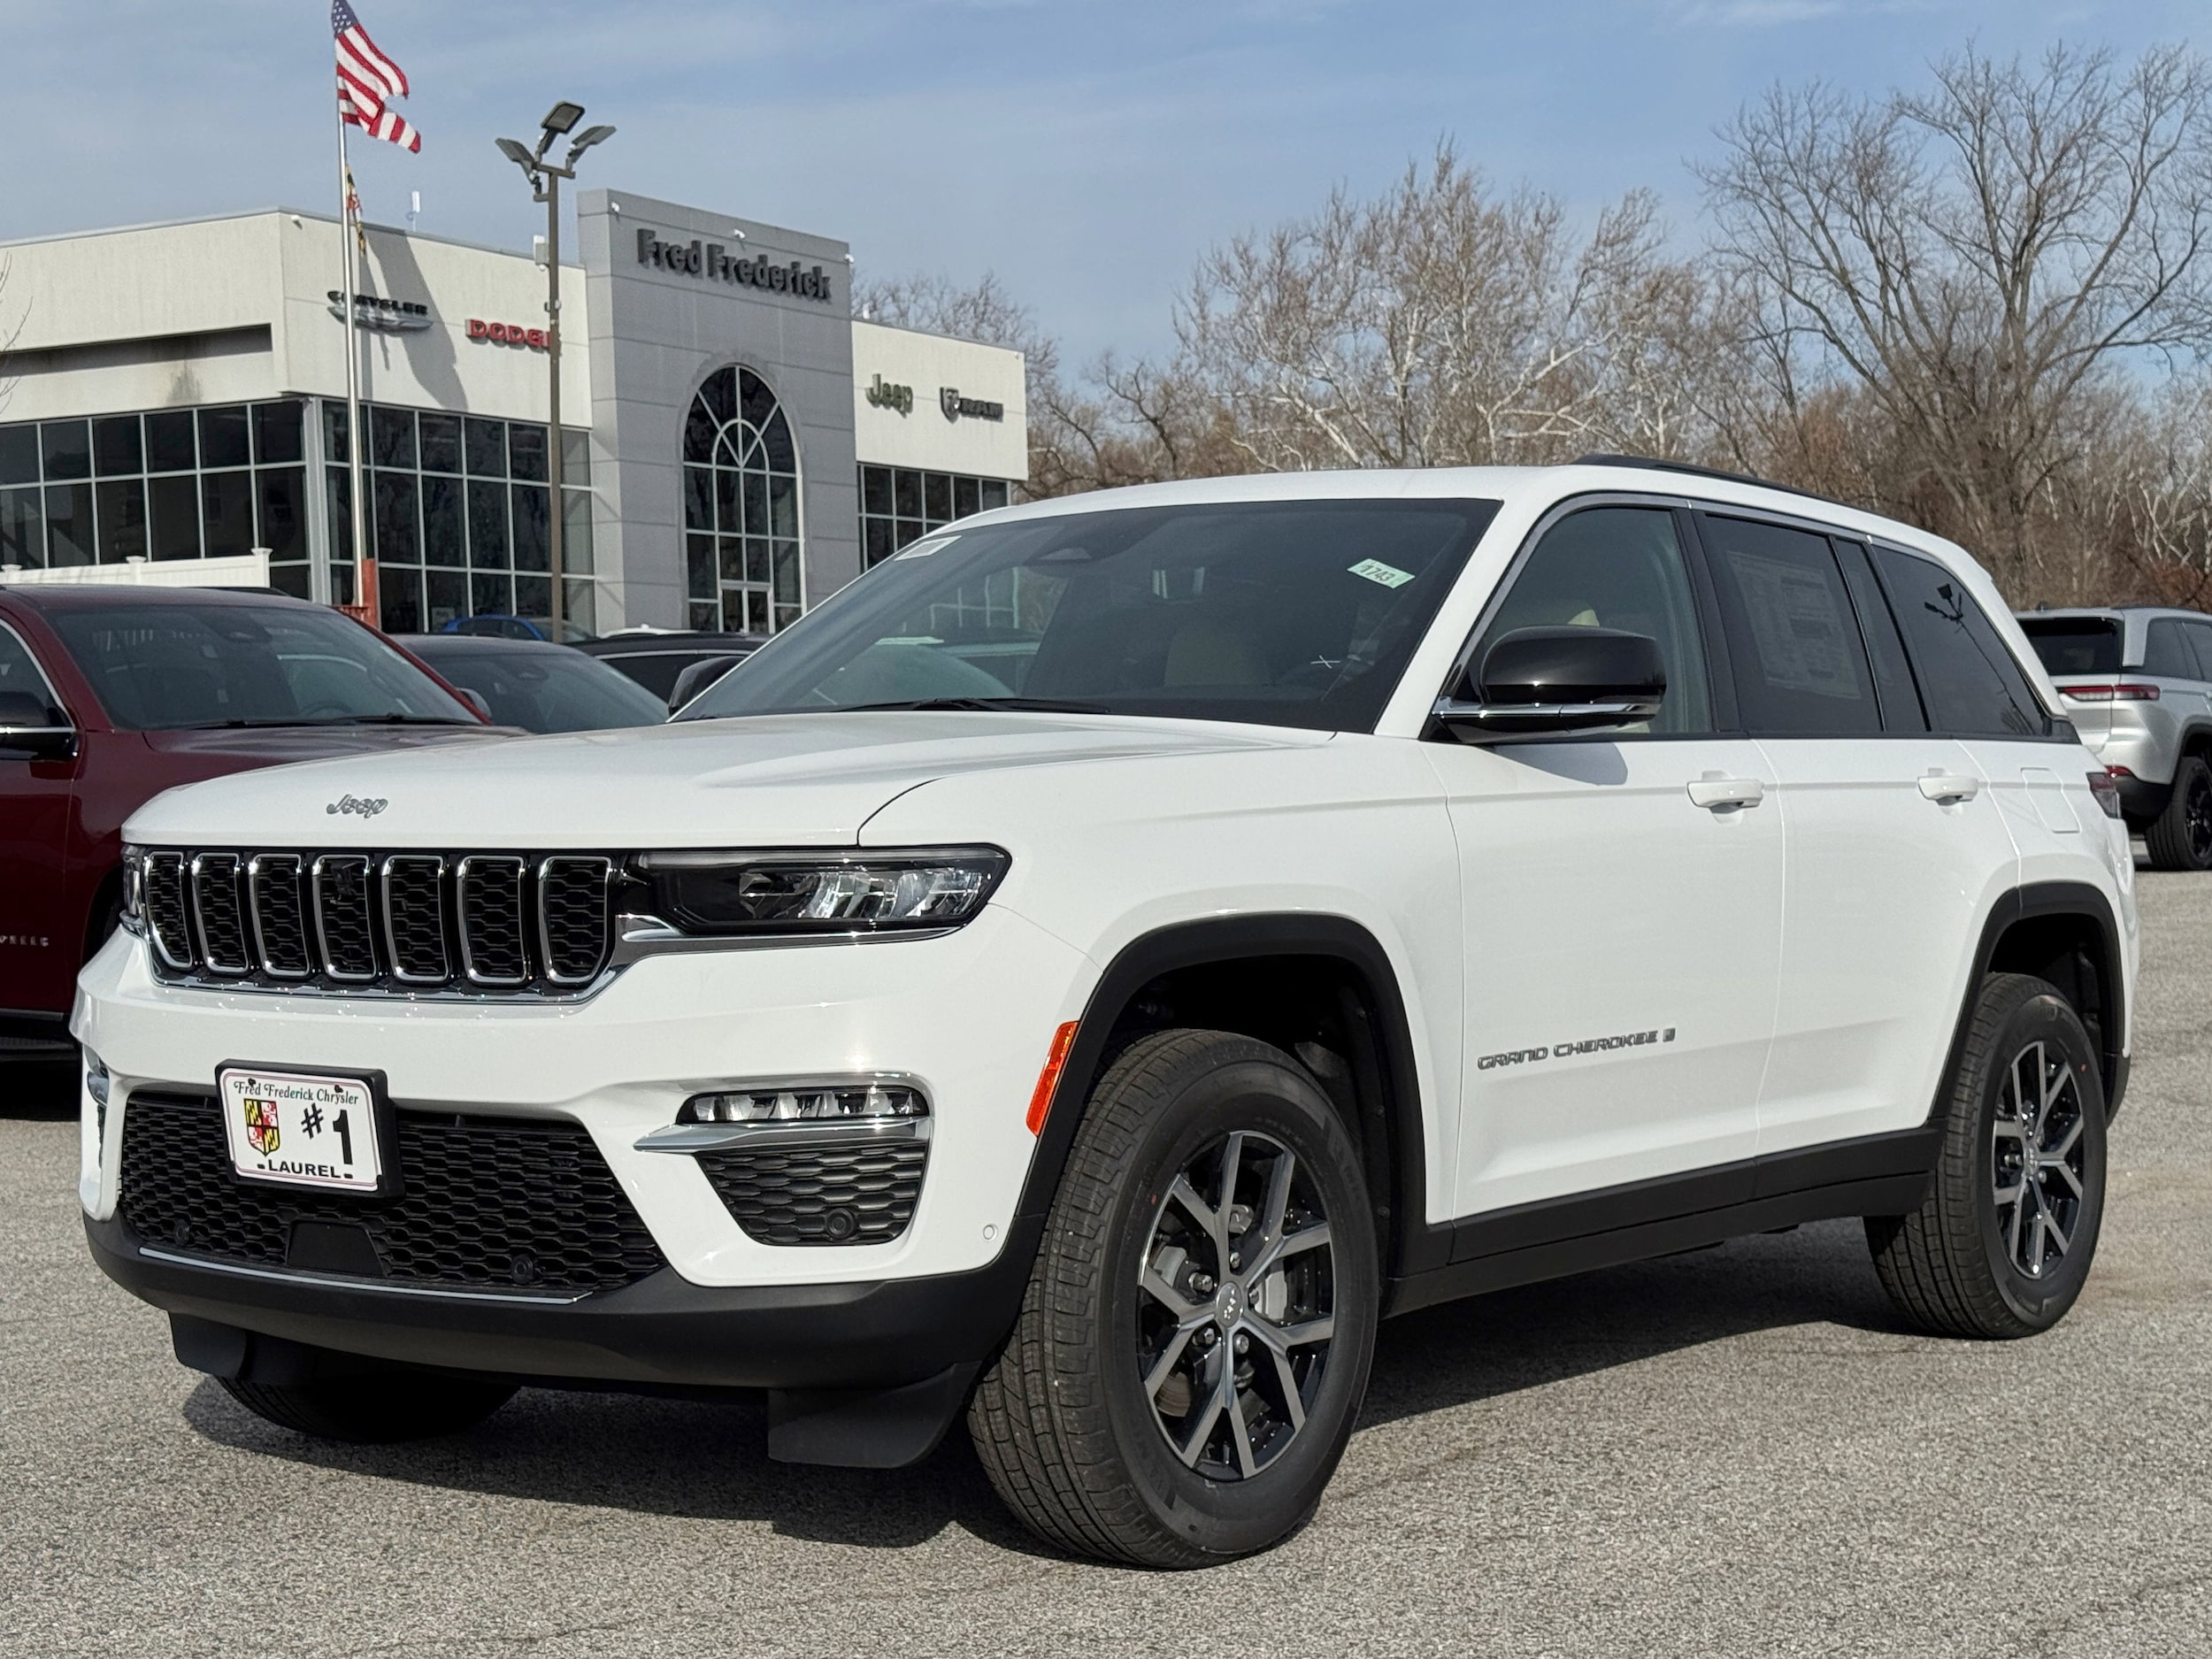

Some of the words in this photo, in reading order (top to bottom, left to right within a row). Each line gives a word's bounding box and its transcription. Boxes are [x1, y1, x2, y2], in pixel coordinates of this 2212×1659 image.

[637, 228, 701, 275] Fred
[707, 243, 831, 301] Frederick
[864, 373, 913, 418] Jeep
[959, 397, 1004, 422] RAM
[1360, 565, 1396, 581] 1743
[326, 794, 389, 818] Jeep
[1478, 1046, 1548, 1070] GRAND
[1554, 1029, 1659, 1058] CHEROKEE
[234, 1080, 261, 1096] Fred
[264, 1083, 313, 1101] Frederick
[317, 1088, 359, 1105] Chrysler
